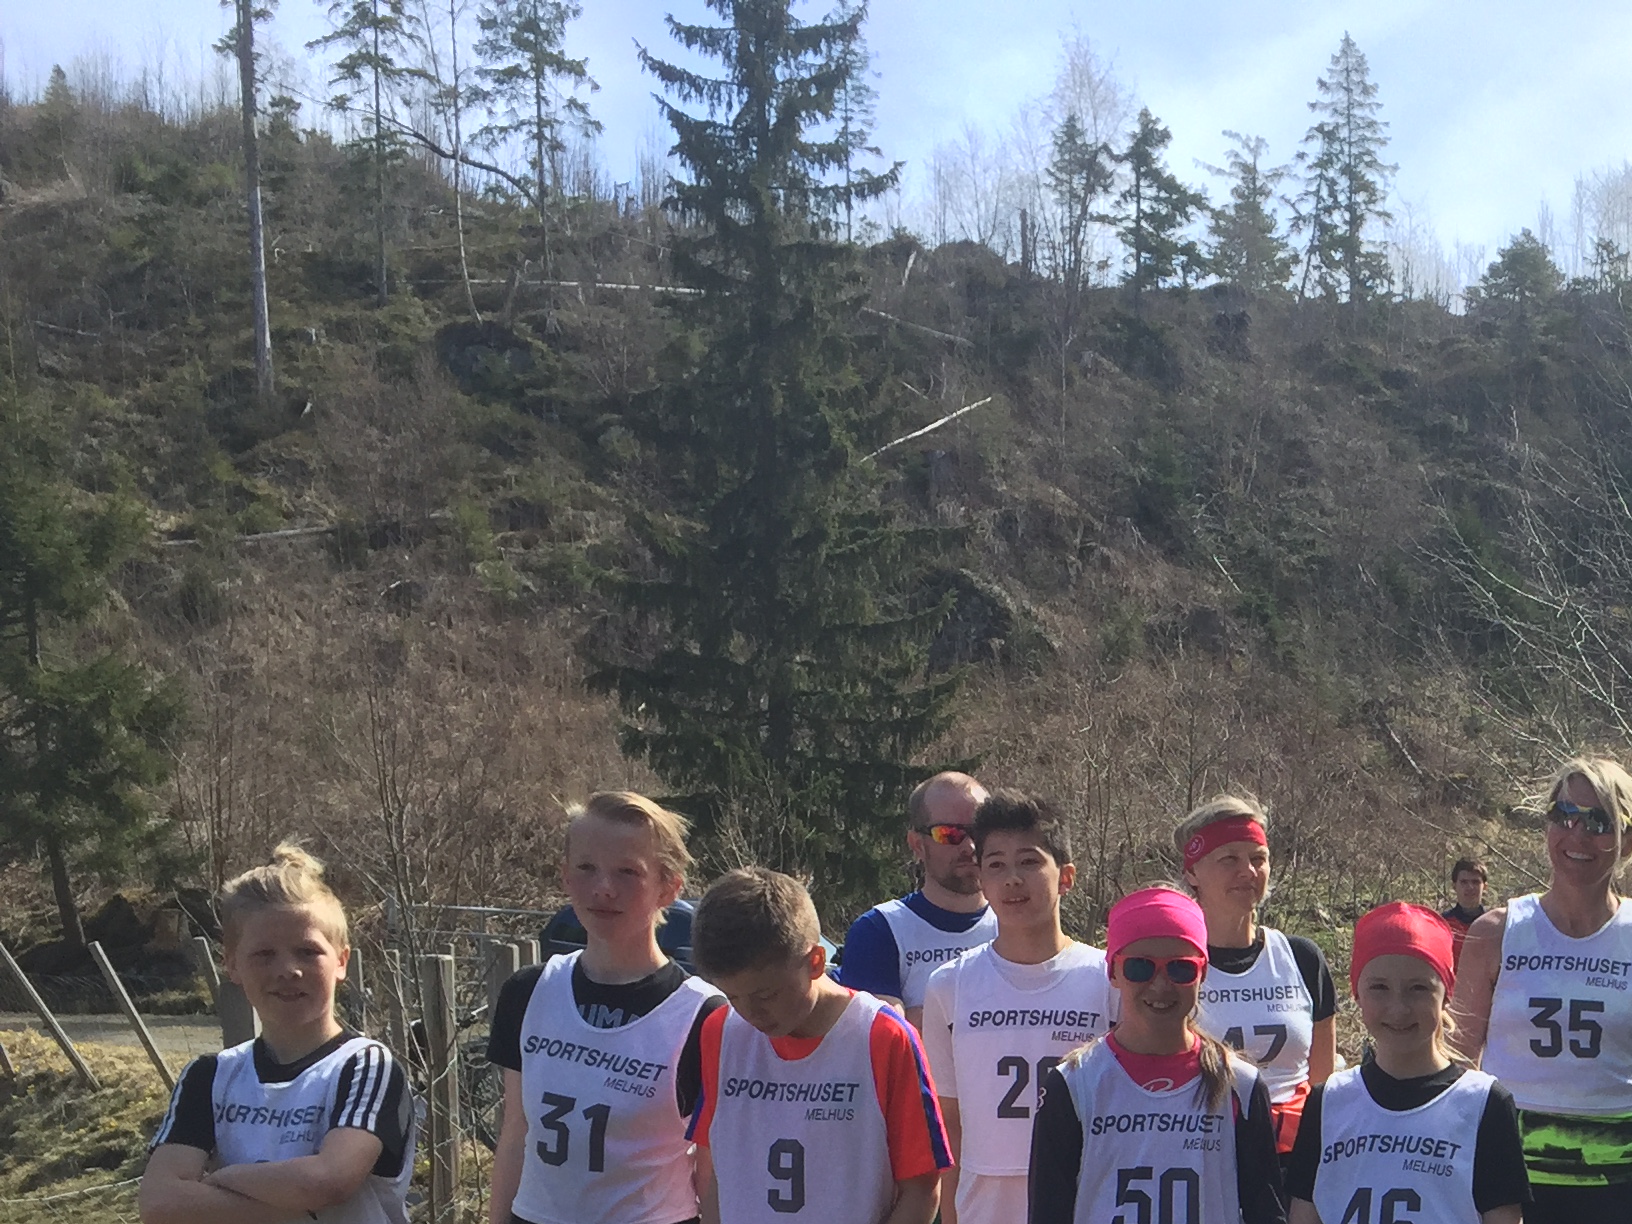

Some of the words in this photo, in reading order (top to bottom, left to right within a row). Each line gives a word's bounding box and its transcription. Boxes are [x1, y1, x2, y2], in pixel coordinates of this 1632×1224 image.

[906, 946, 968, 966] SPORTS
[1505, 954, 1632, 977] SPORTSHUSET
[1585, 976, 1629, 991] MELHUS
[1198, 985, 1301, 1005] PORTSHUSET
[968, 1010, 1100, 1029] SPORTSHUSET
[1528, 997, 1605, 1058] 35
[1051, 1031, 1095, 1042] MELHUS
[524, 1035, 668, 1082] SPORTSHUSET
[603, 1077, 657, 1099] MELHUS
[724, 1078, 859, 1102] SPORTSHUSET
[804, 1108, 855, 1121] MELHUS
[1091, 1113, 1224, 1135] SPORTSHUSET
[537, 1091, 611, 1173] 31
[1323, 1134, 1461, 1164] SPORTSHUSET
[767, 1138, 805, 1213] 9
[1402, 1159, 1454, 1177] MELHUS
